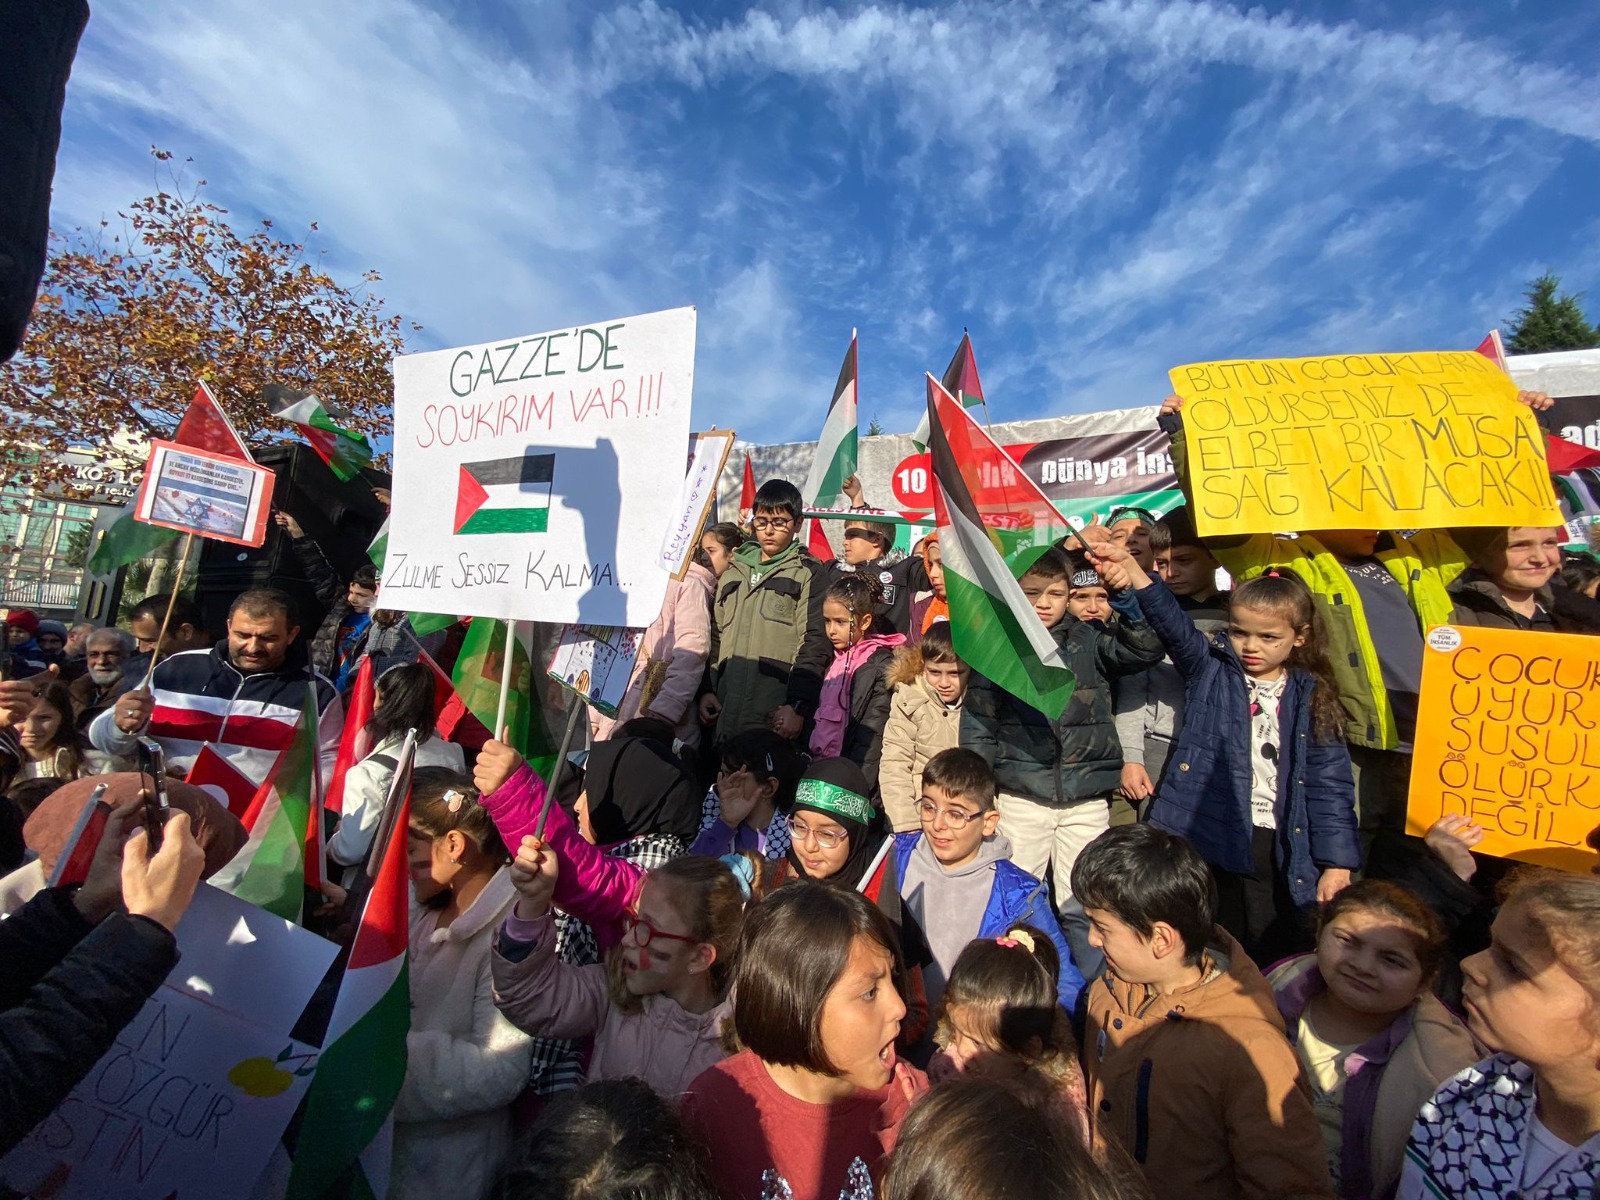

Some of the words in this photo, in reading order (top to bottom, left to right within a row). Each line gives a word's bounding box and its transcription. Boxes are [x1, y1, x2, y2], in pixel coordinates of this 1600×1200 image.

[450, 324, 625, 397] GAZZE'DE
[1186, 362, 1295, 392] BÜTÜN
[1302, 351, 1488, 383] ÇOCUKLARI
[416, 391, 555, 449] SOYKIRIM
[569, 371, 664, 423] VAR!!!
[1190, 384, 1415, 432] ÖLDÜRSENİZ
[1417, 381, 1482, 417] DE
[1201, 424, 1326, 472] ELBET
[1340, 419, 1405, 464] BİR
[897, 467, 927, 495] 10
[1202, 468, 1299, 520] SAĞ
[385, 553, 444, 589] ZULME
